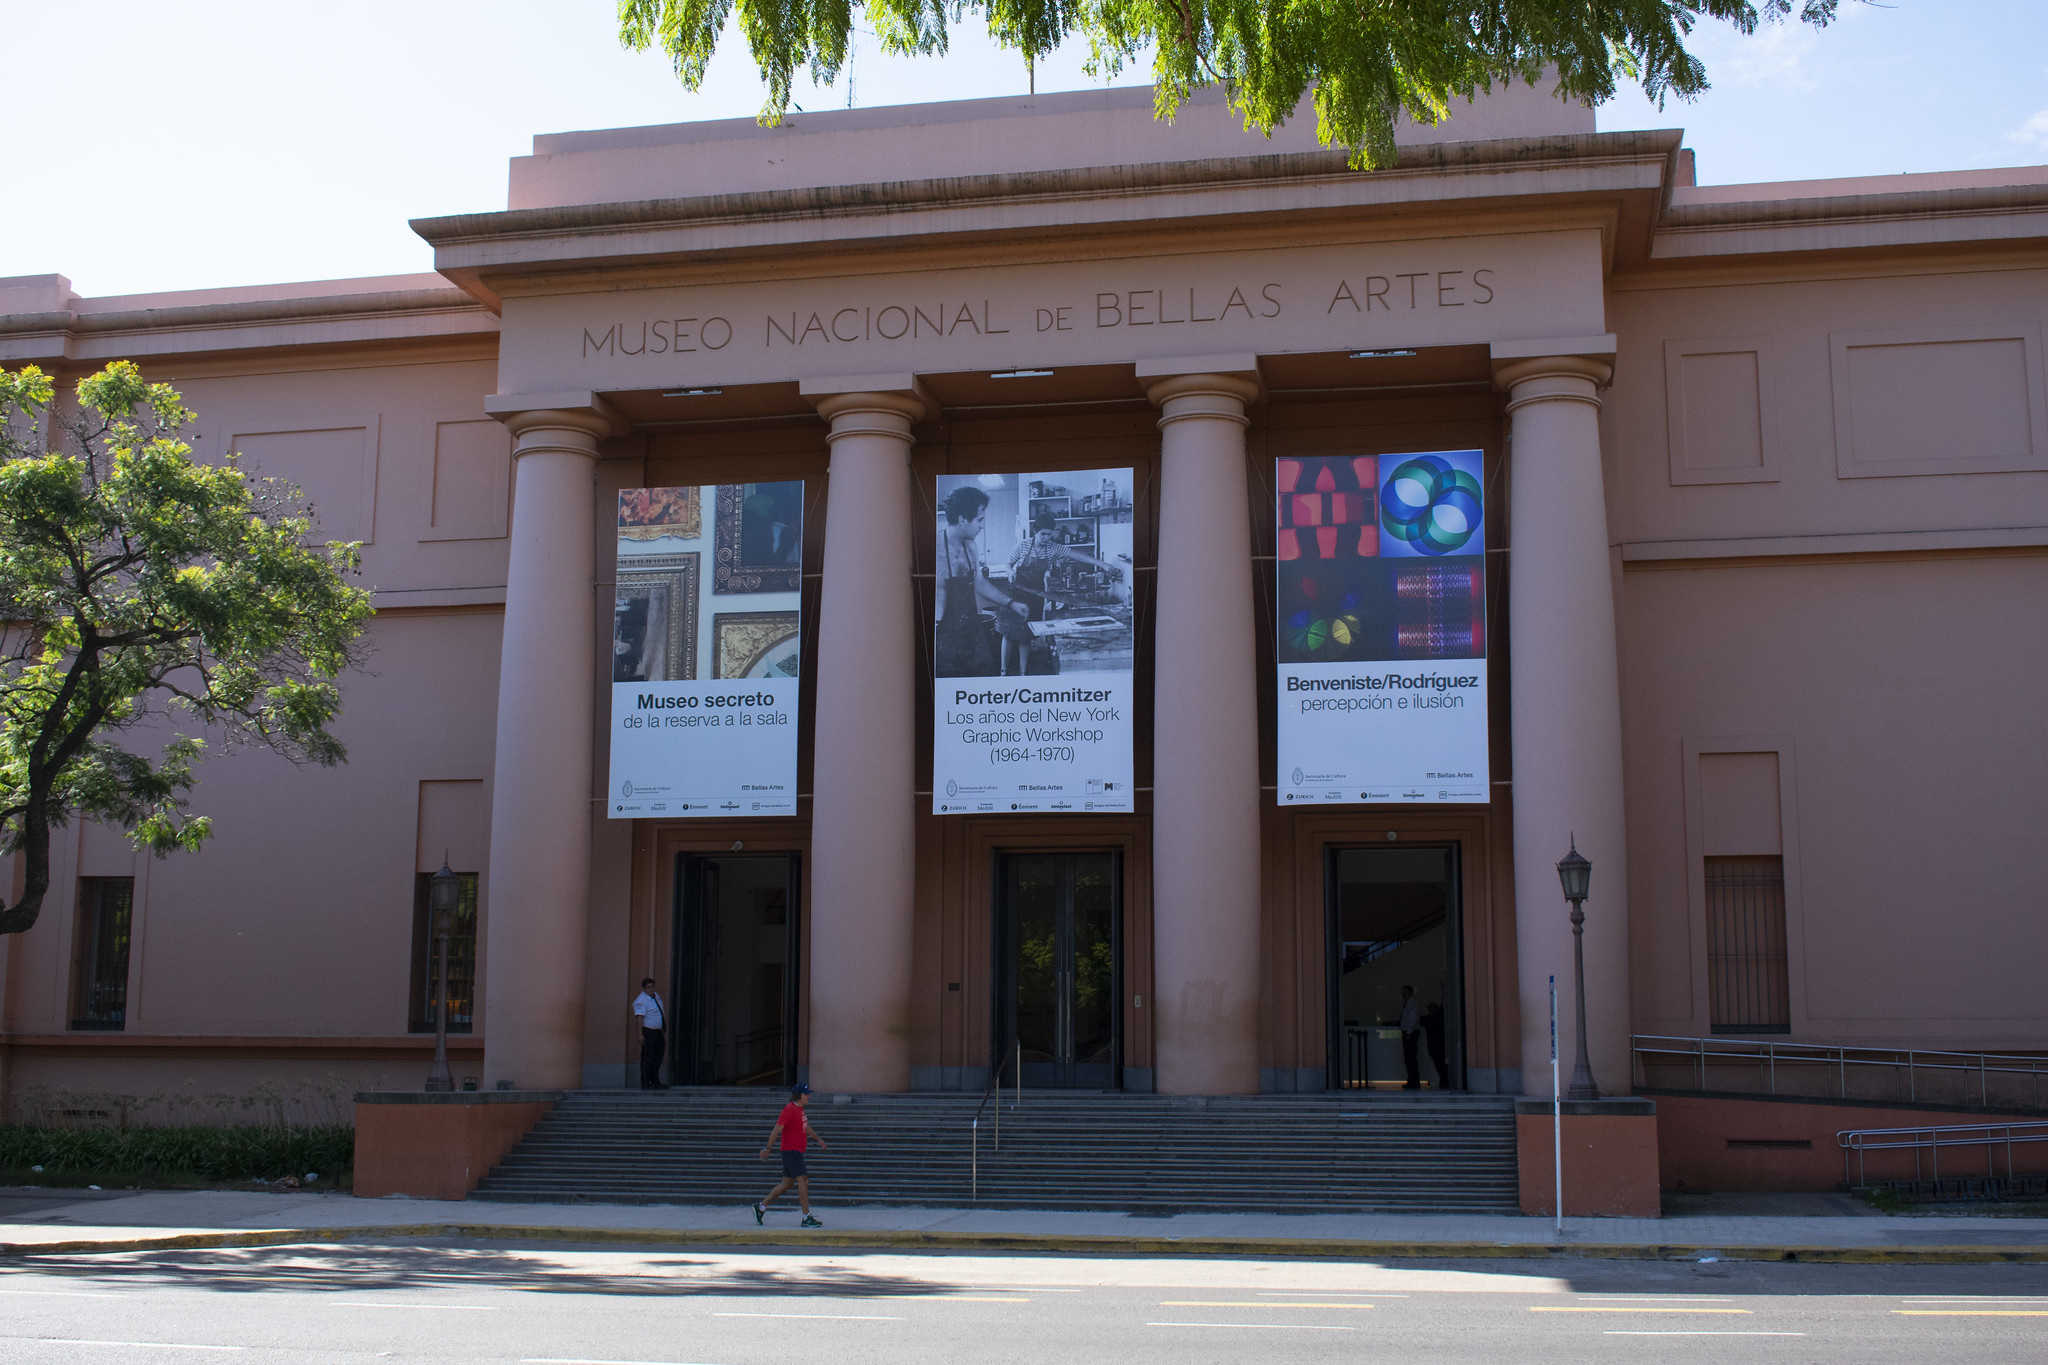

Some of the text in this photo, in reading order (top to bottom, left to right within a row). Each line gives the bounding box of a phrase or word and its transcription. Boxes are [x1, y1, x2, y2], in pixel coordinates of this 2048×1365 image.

[583, 269, 1494, 358] MUSEO NACIONAL DE BELLAS ARTES
[1287, 672, 1479, 692] Benveniste/Rodríguez
[637, 692, 774, 710] Museo secreto
[955, 688, 1111, 705] Porter/Camnitzer
[1301, 693, 1464, 714] percepción e ilusión
[623, 711, 787, 728] de la reserva a la sala
[947, 707, 1120, 724] Los años del New York
[962, 727, 1103, 745] Graphic Workshop
[990, 746, 1075, 765] (1964-1970)
